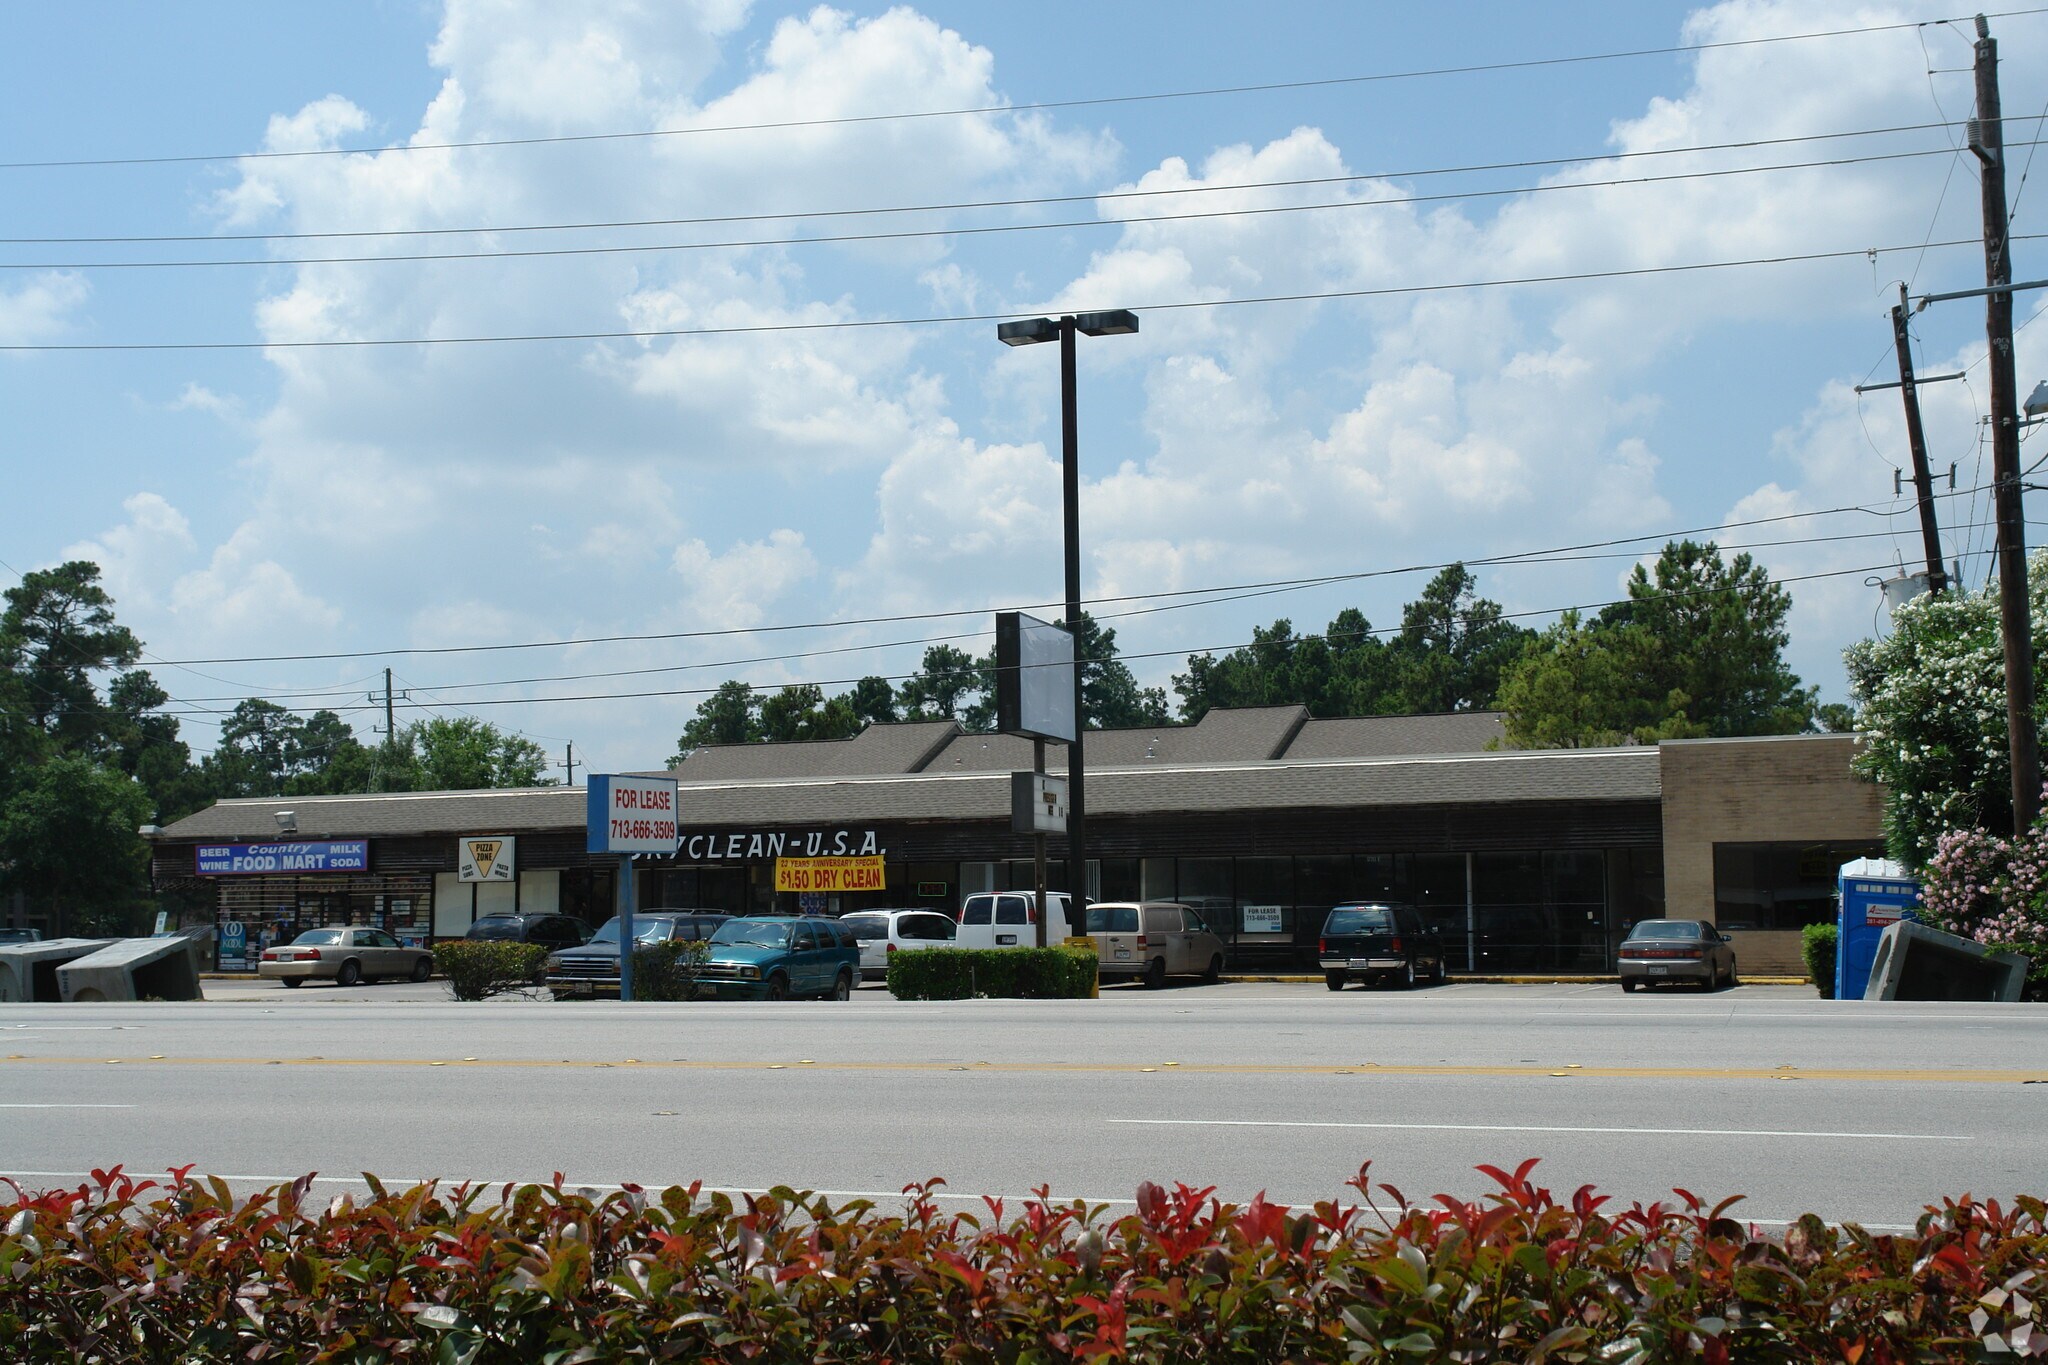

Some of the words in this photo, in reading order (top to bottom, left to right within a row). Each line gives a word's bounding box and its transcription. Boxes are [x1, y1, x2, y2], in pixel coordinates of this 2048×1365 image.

[616, 789, 637, 808] FOR
[641, 790, 671, 810] LEASE
[611, 820, 675, 839] 713-666-3509
[200, 848, 231, 857] BEER
[248, 844, 312, 855] Country
[330, 845, 361, 854] MILK
[476, 844, 493, 852] PIZZA
[477, 853, 493, 861] ZONE
[200, 861, 230, 871] WINE
[233, 856, 276, 871] FOOD
[283, 855, 326, 870] MART
[330, 858, 361, 868] SODA
[812, 859, 853, 868] ANNIVERSARY
[855, 858, 879, 867] SPECIAL
[781, 870, 809, 888] $1.50
[814, 869, 838, 888] DRY
[843, 869, 881, 888] CLEAN
[222, 939, 243, 948] KOOL
